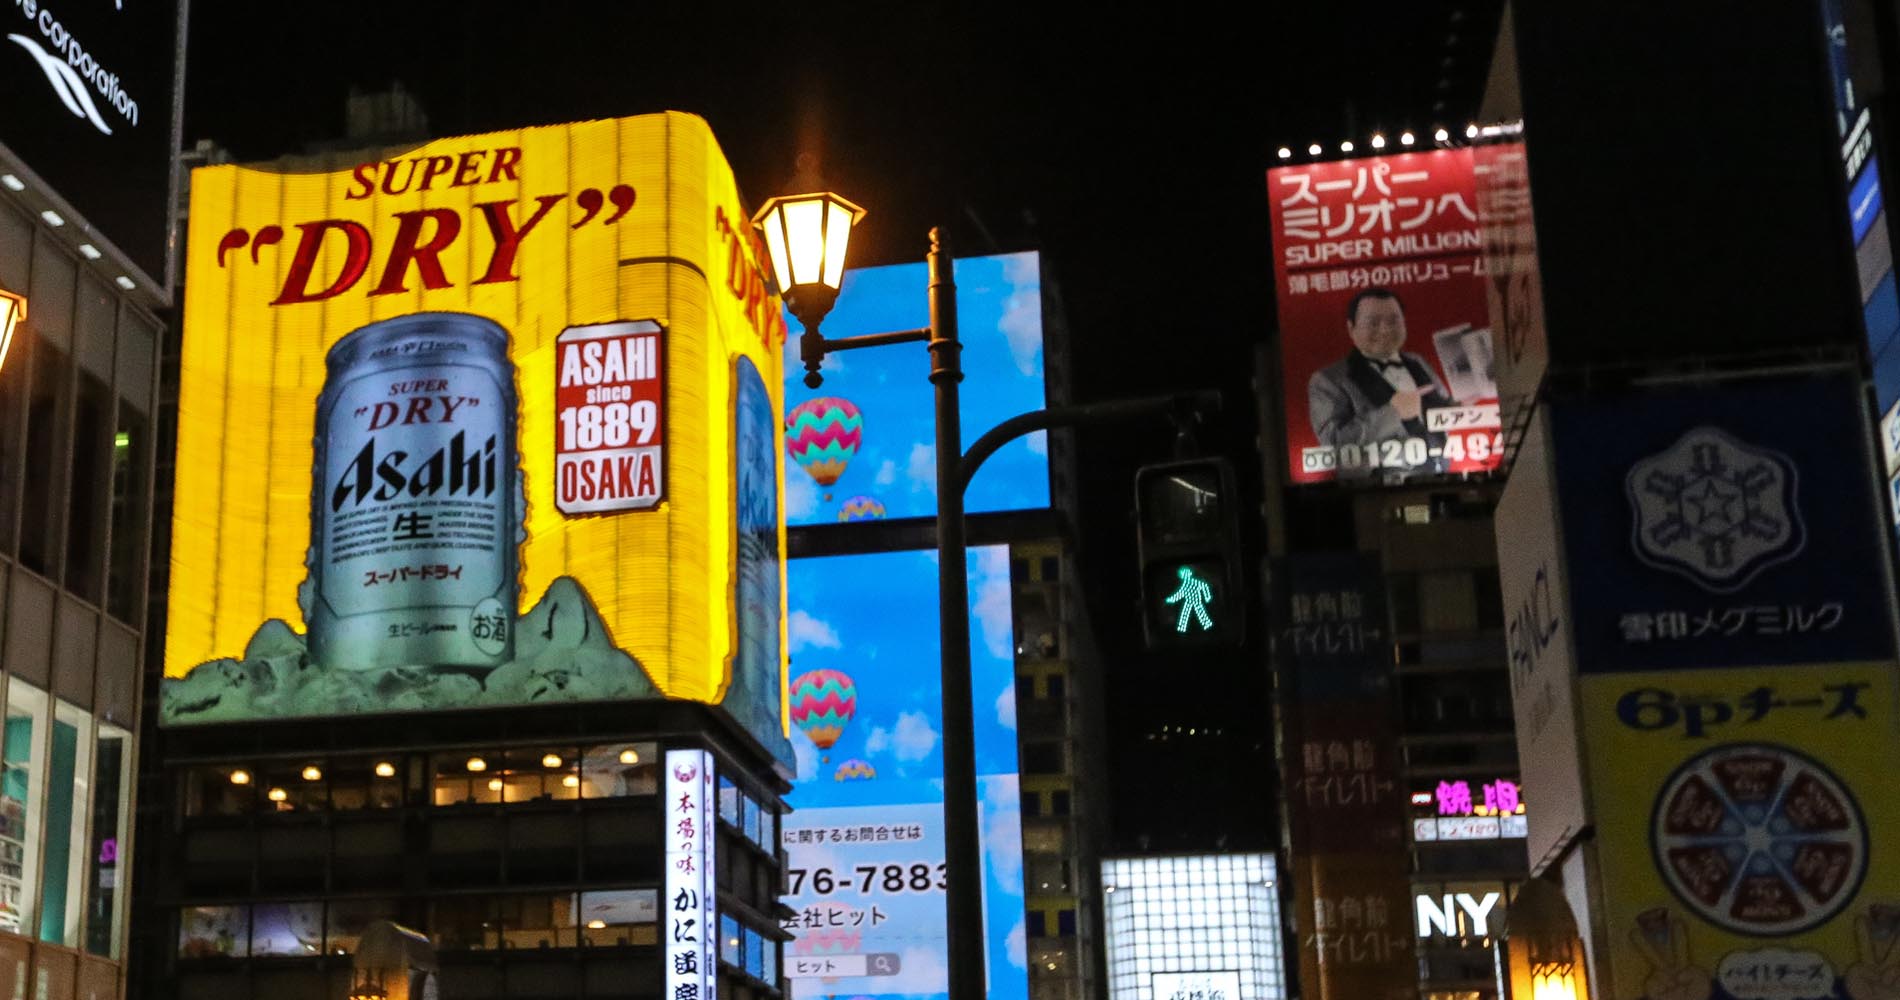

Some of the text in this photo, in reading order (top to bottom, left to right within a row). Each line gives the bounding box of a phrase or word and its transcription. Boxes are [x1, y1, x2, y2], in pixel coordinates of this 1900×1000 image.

[38, 9, 139, 127] corporation
[345, 146, 522, 200] SUPER
[1280, 161, 1429, 208] スーパー
[1282, 192, 1477, 240] ミリオンへ
[1285, 229, 1482, 267] SUPER MILLION
[560, 335, 657, 388] ASAHI
[388, 379, 449, 397] SUPER
[586, 384, 632, 405] since
[560, 399, 657, 451] 1889
[332, 429, 497, 513] Asahi
[562, 453, 656, 503] OSAKA
[392, 510, 434, 542] 生
[363, 564, 463, 588] スーパードライ
[1617, 600, 1844, 644] 雪印メグミルク
[783, 825, 922, 844] に関するお問合せは
[1416, 892, 1500, 937] NY
[796, 960, 836, 974] ヒット
